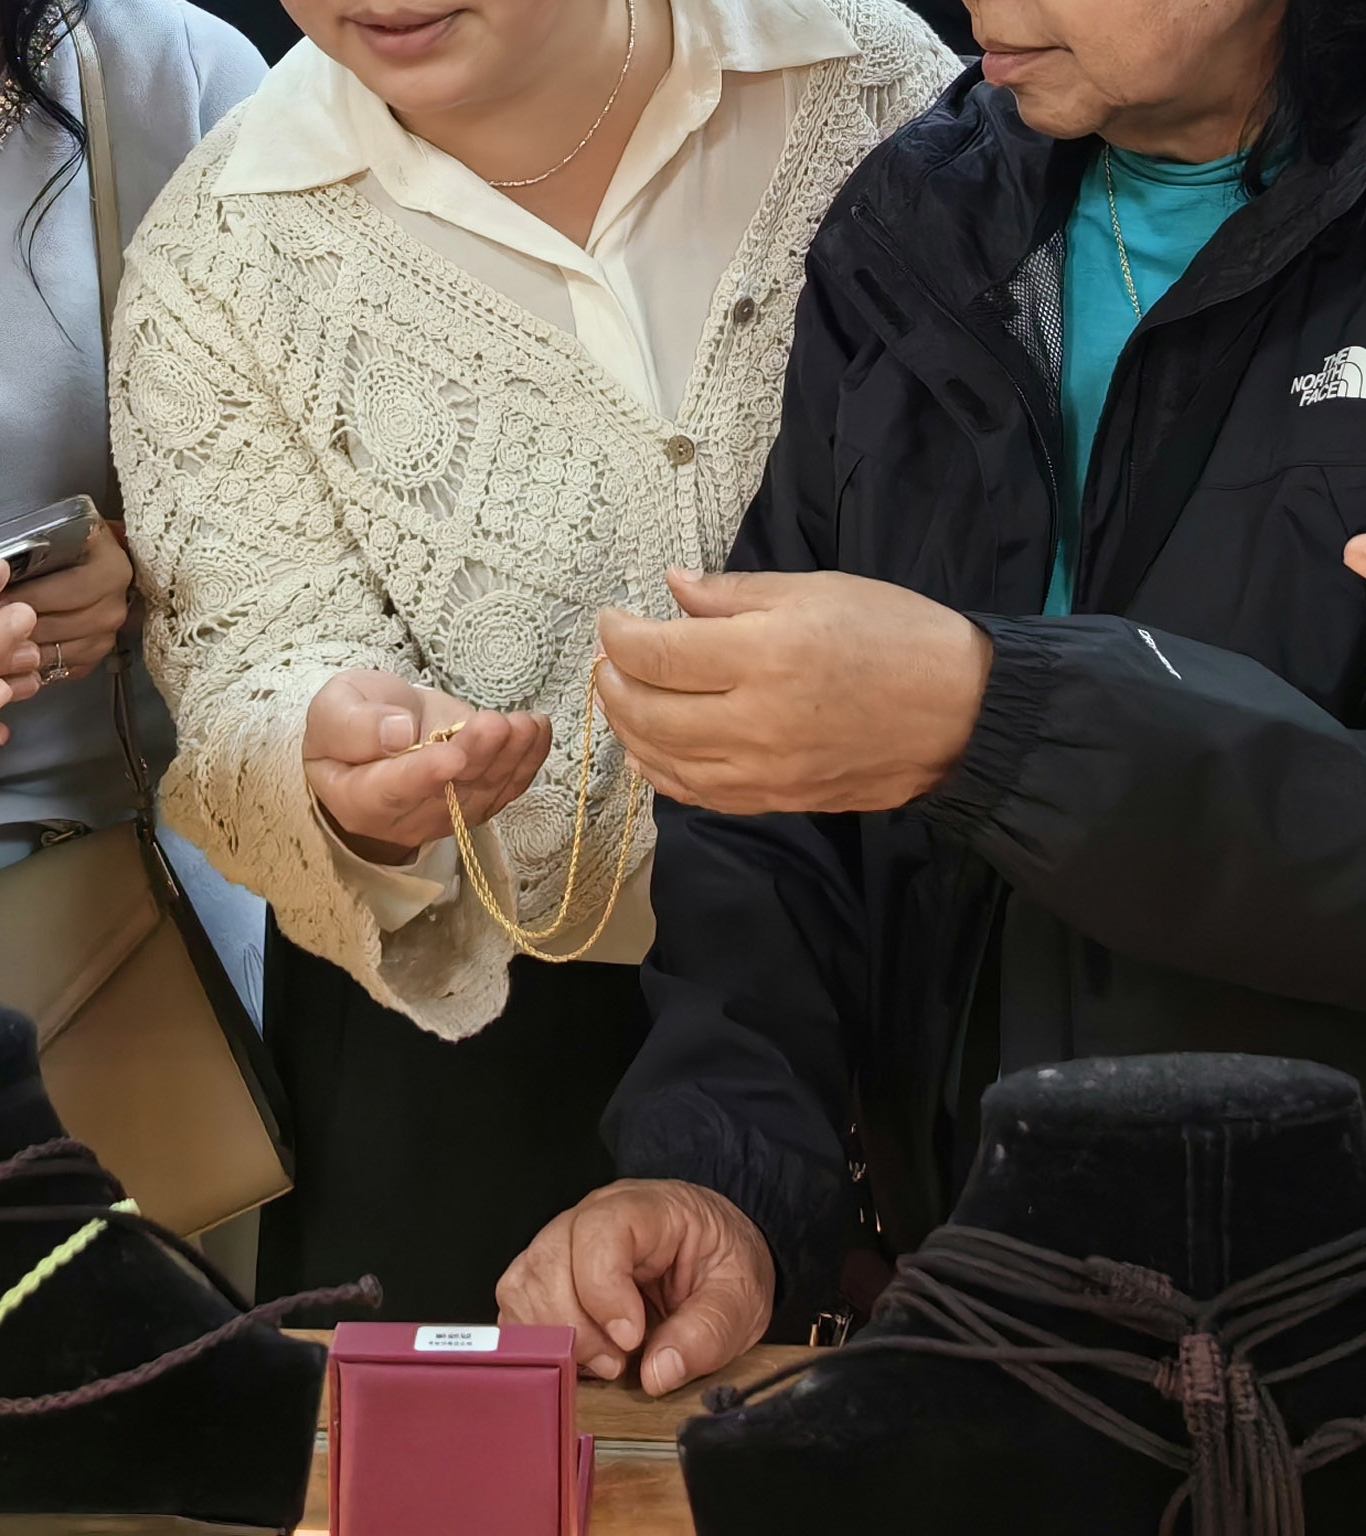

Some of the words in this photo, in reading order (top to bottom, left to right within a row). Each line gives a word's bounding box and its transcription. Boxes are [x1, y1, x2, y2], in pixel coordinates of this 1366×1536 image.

[1322, 346, 1351, 372] THE
[1290, 363, 1345, 394] NORTH
[1299, 380, 1341, 407] FACE
